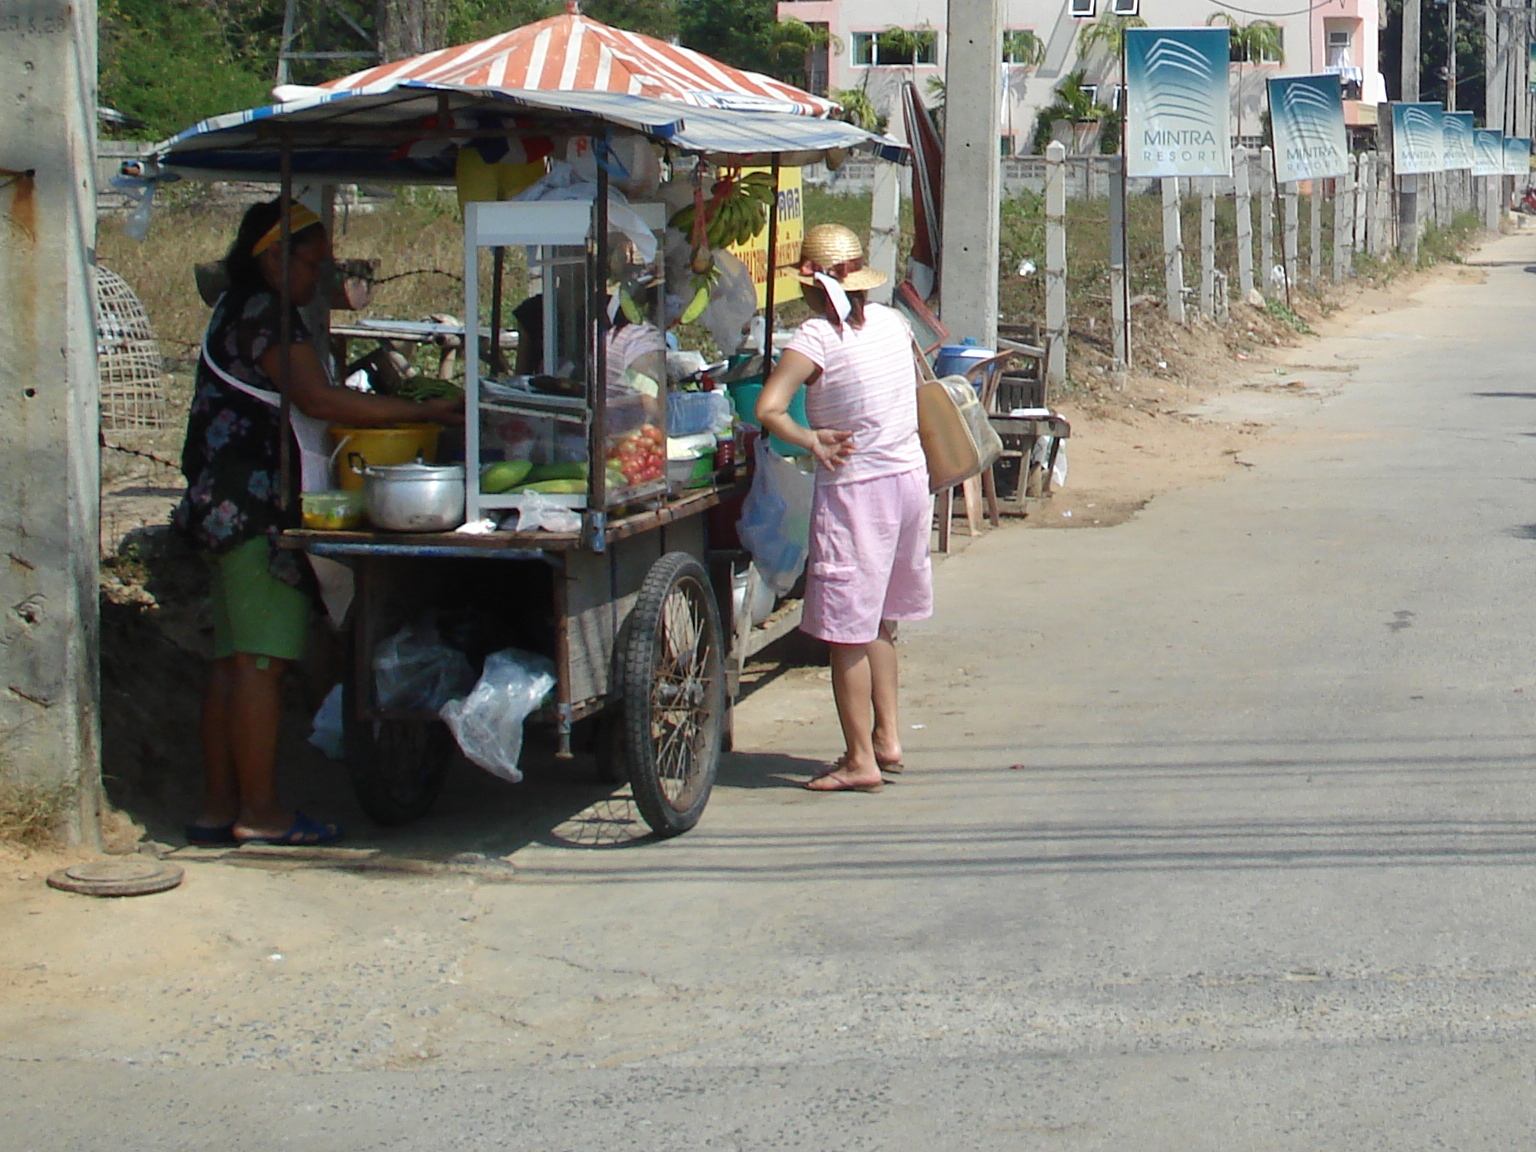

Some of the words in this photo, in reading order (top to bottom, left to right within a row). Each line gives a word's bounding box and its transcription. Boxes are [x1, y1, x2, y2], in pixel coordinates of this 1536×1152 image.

[1144, 130, 1216, 145] MINTRA
[1143, 151, 1216, 162] RESORT
[1286, 145, 1338, 160] MINTRA
[1287, 158, 1339, 172] RESORT
